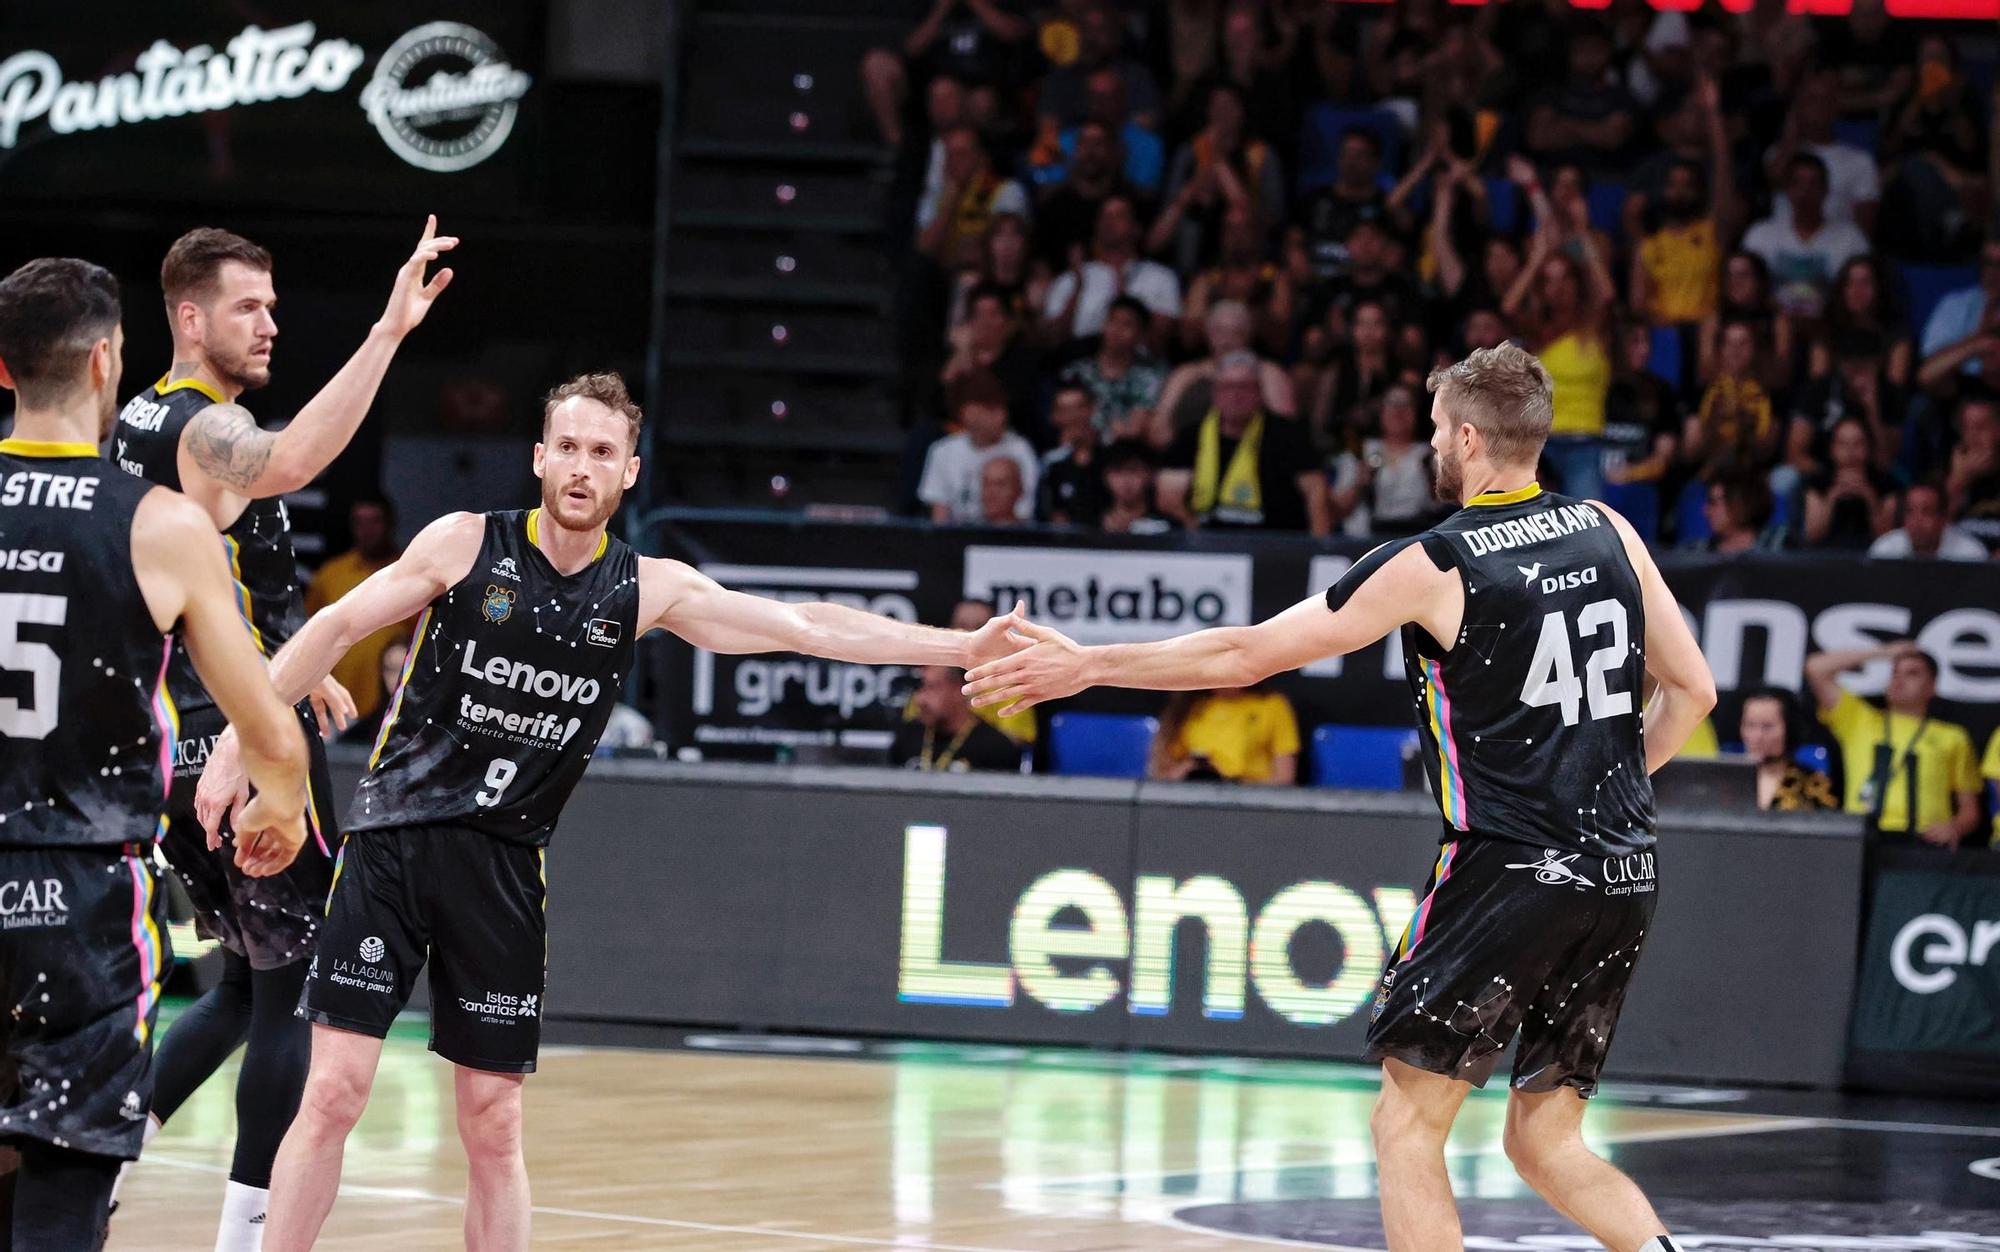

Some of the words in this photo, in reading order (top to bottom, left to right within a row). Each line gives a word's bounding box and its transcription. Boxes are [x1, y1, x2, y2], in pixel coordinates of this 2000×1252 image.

[0, 471, 100, 511] STRE
[1461, 504, 1601, 558] DOORNEKAMP
[1541, 566, 1598, 595] DISA
[990, 575, 1225, 623] metabo
[460, 639, 601, 705] Lenovo
[1519, 598, 1633, 727] 42
[456, 717, 504, 739] despierta
[475, 757, 519, 808] 9
[1603, 852, 1656, 884] CICAR
[1605, 884, 1632, 897] Canary
[44, 912, 68, 927] Car
[333, 958, 348, 973] LA
[330, 972, 366, 989] deporte
[366, 982, 385, 993] para
[386, 984, 395, 994] ti
[486, 991, 518, 1006] Islas
